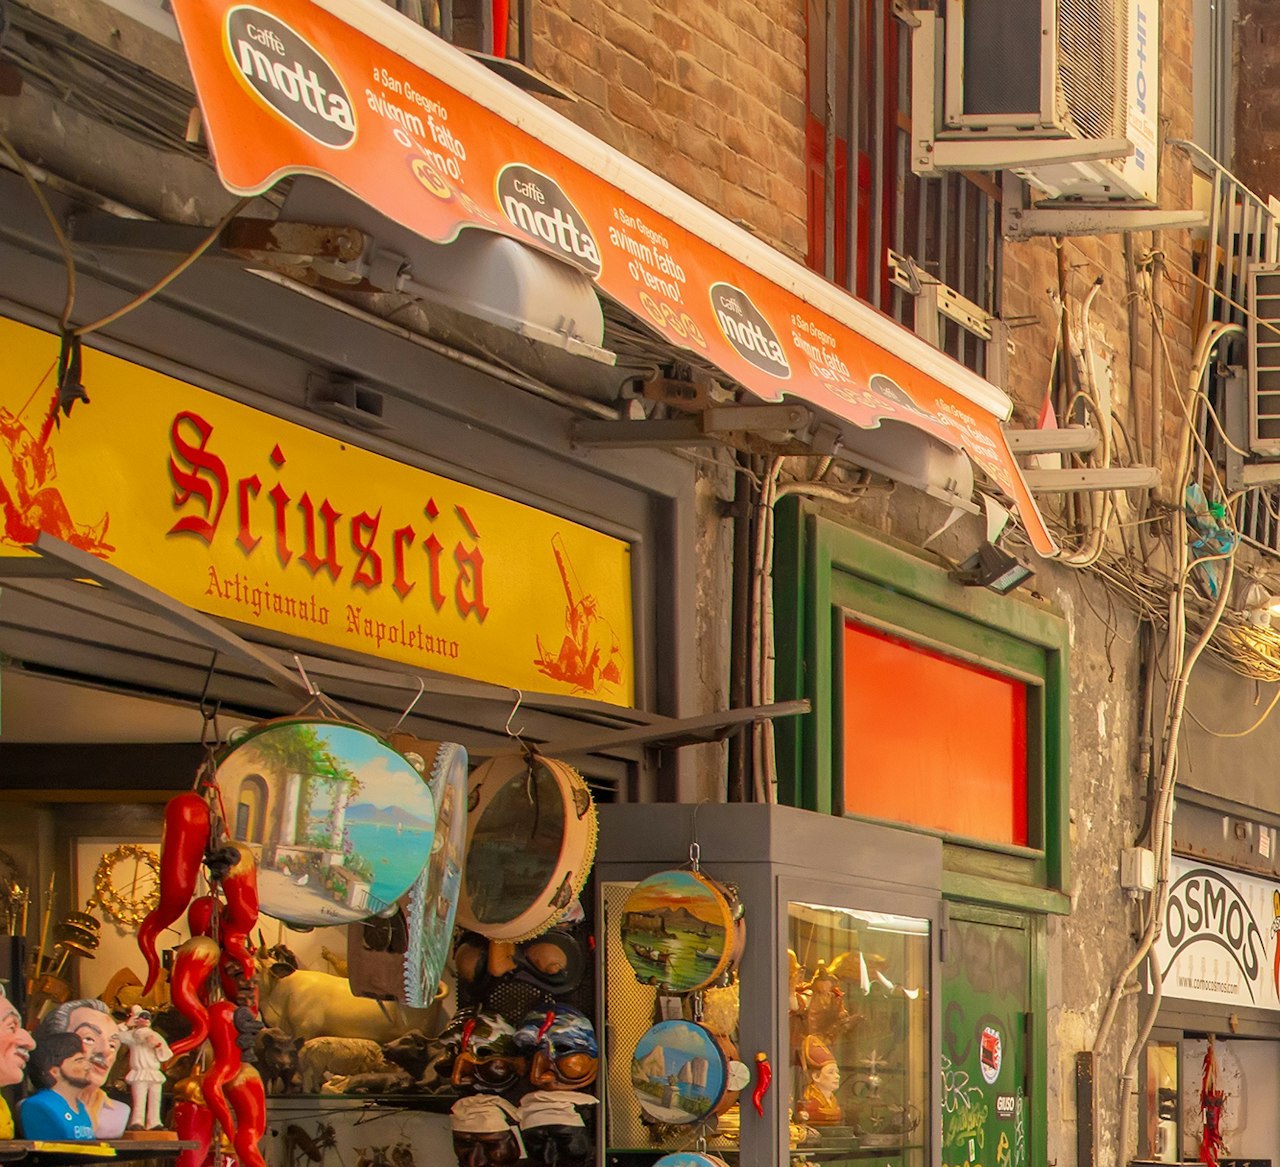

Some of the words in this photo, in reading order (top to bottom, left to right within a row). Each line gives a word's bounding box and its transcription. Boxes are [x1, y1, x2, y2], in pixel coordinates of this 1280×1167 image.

[246, 22, 286, 57] caffè
[238, 39, 356, 132] motta
[373, 67, 380, 81] a
[381, 70, 402, 94] San
[403, 82, 448, 121] Gregorio
[365, 88, 426, 139] avimm
[427, 116, 467, 161] fatto
[513, 178, 545, 205] caffè
[504, 195, 601, 266] motta
[608, 226, 654, 265] avimm
[655, 252, 686, 283] fatto
[612, 207, 619, 220] a
[619, 209, 636, 229] San
[637, 218, 669, 249] Gregorio
[720, 295, 744, 317] caffè
[790, 313, 796, 326] a
[796, 314, 810, 334] San
[809, 321, 837, 348] Gregorio
[717, 309, 790, 368] motta
[822, 348, 850, 378] fatto
[165, 409, 490, 626] Sciuscià
[204, 565, 330, 626] Artigianato
[346, 603, 460, 659] Napoletano
[996, 1095, 1015, 1112] GIUSO
